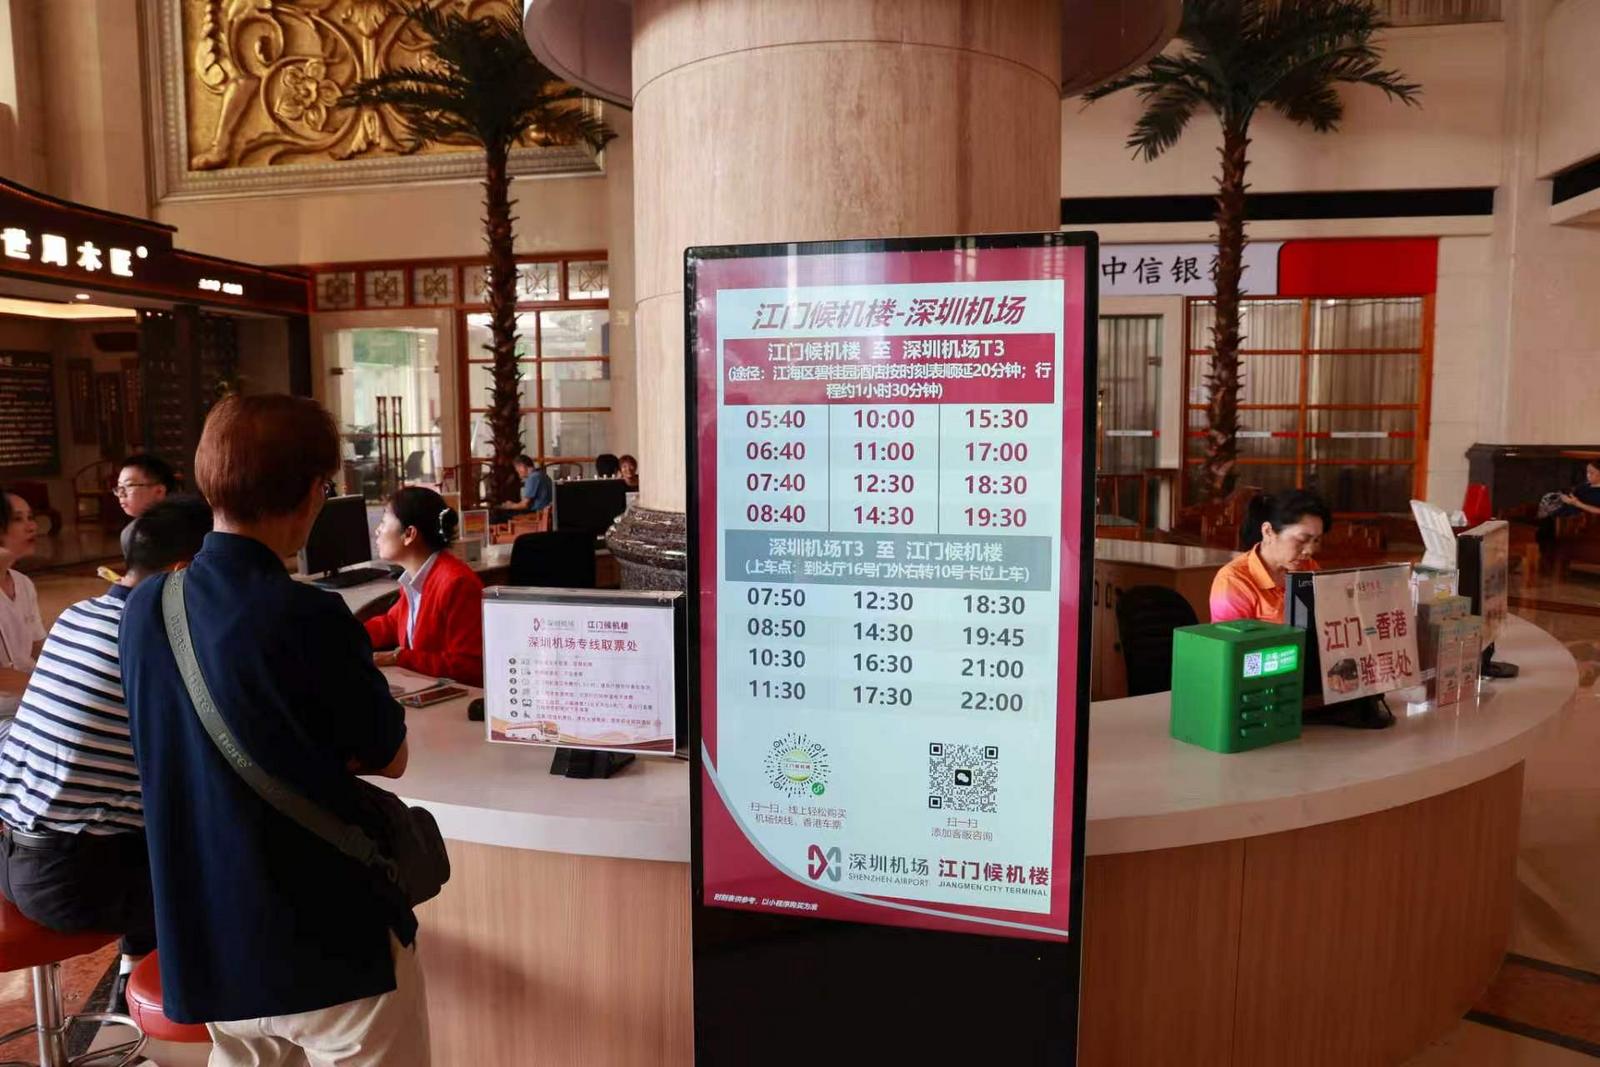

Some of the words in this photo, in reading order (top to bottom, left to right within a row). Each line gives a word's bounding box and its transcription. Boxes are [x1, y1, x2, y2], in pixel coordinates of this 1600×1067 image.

[1101, 256, 1219, 286] 中信银
[752, 296, 1026, 330] 江门候机楼-深圳机场
[768, 342, 860, 361] 江门候机楼
[872, 341, 891, 359] 至
[903, 339, 1005, 359] 深圳机场T3
[747, 410, 805, 428] 05:40
[854, 410, 914, 428] 10:00
[966, 409, 1028, 428] 15:30
[747, 442, 805, 460] 06:40
[854, 442, 914, 460] 11:00
[966, 443, 1027, 461] 17:00
[747, 473, 805, 491] 07:40
[854, 474, 914, 493] 12:30
[965, 476, 1027, 494] 18:30
[747, 505, 805, 523] 08:40
[854, 506, 913, 525] 14:30
[965, 508, 1026, 527] 19:30
[769, 538, 864, 557] 深圳机场T3
[876, 541, 895, 558] 至
[906, 541, 1003, 562] 江门候机楼
[748, 588, 805, 606] 07:50
[854, 591, 913, 610] 12:30
[964, 595, 1025, 615] 18:30
[528, 635, 638, 652] 深圳机场专线取票处
[748, 618, 805, 637] 08:50
[854, 623, 912, 642] 14:30
[963, 627, 1024, 646] 19:45
[750, 648, 805, 667] 10:30
[854, 654, 912, 673] 16:30
[962, 659, 1023, 678] 21:00
[1359, 649, 1412, 686] 验票处
[749, 680, 805, 699] 11:30
[854, 686, 912, 705] 17:30
[961, 692, 1022, 711] 22:00
[947, 817, 978, 828] 扫一扫
[848, 853, 929, 877] 深圳机场
[938, 859, 1049, 886] 江门候机楼
[848, 873, 893, 884] SHENZHEN
[894, 877, 929, 887] AIRPORT
[938, 881, 981, 891] JIANGMEN
[1004, 887, 1048, 897] TERMINAL
